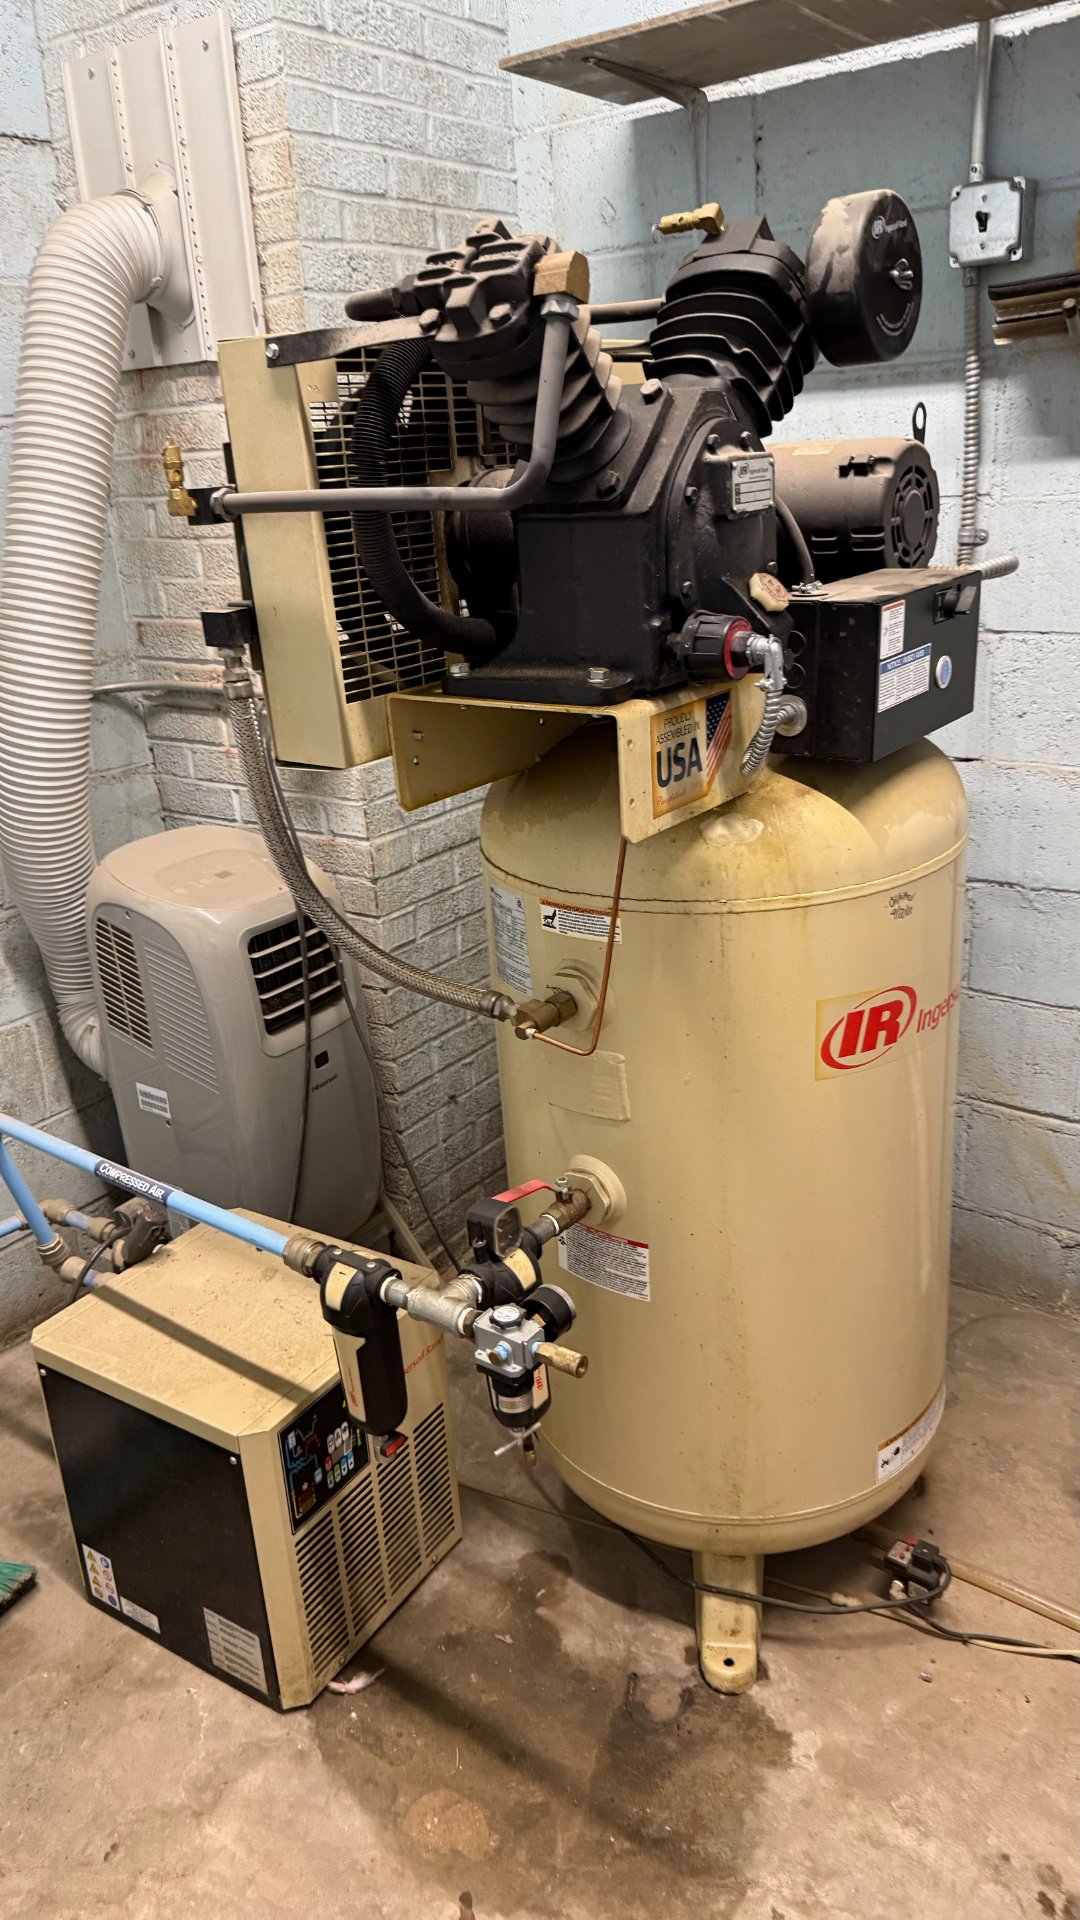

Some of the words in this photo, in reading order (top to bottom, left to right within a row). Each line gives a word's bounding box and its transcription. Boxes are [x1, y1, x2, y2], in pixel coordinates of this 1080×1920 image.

[656, 723, 693, 745] ASSEMBLED
[663, 710, 692, 729] PROUDLY
[656, 736, 703, 788] USA
[836, 998, 905, 1060] IR
[99, 1162, 150, 1192] COMPRESSED
[148, 1184, 165, 1199] AIR
[426, 1332, 444, 1357] Rand
